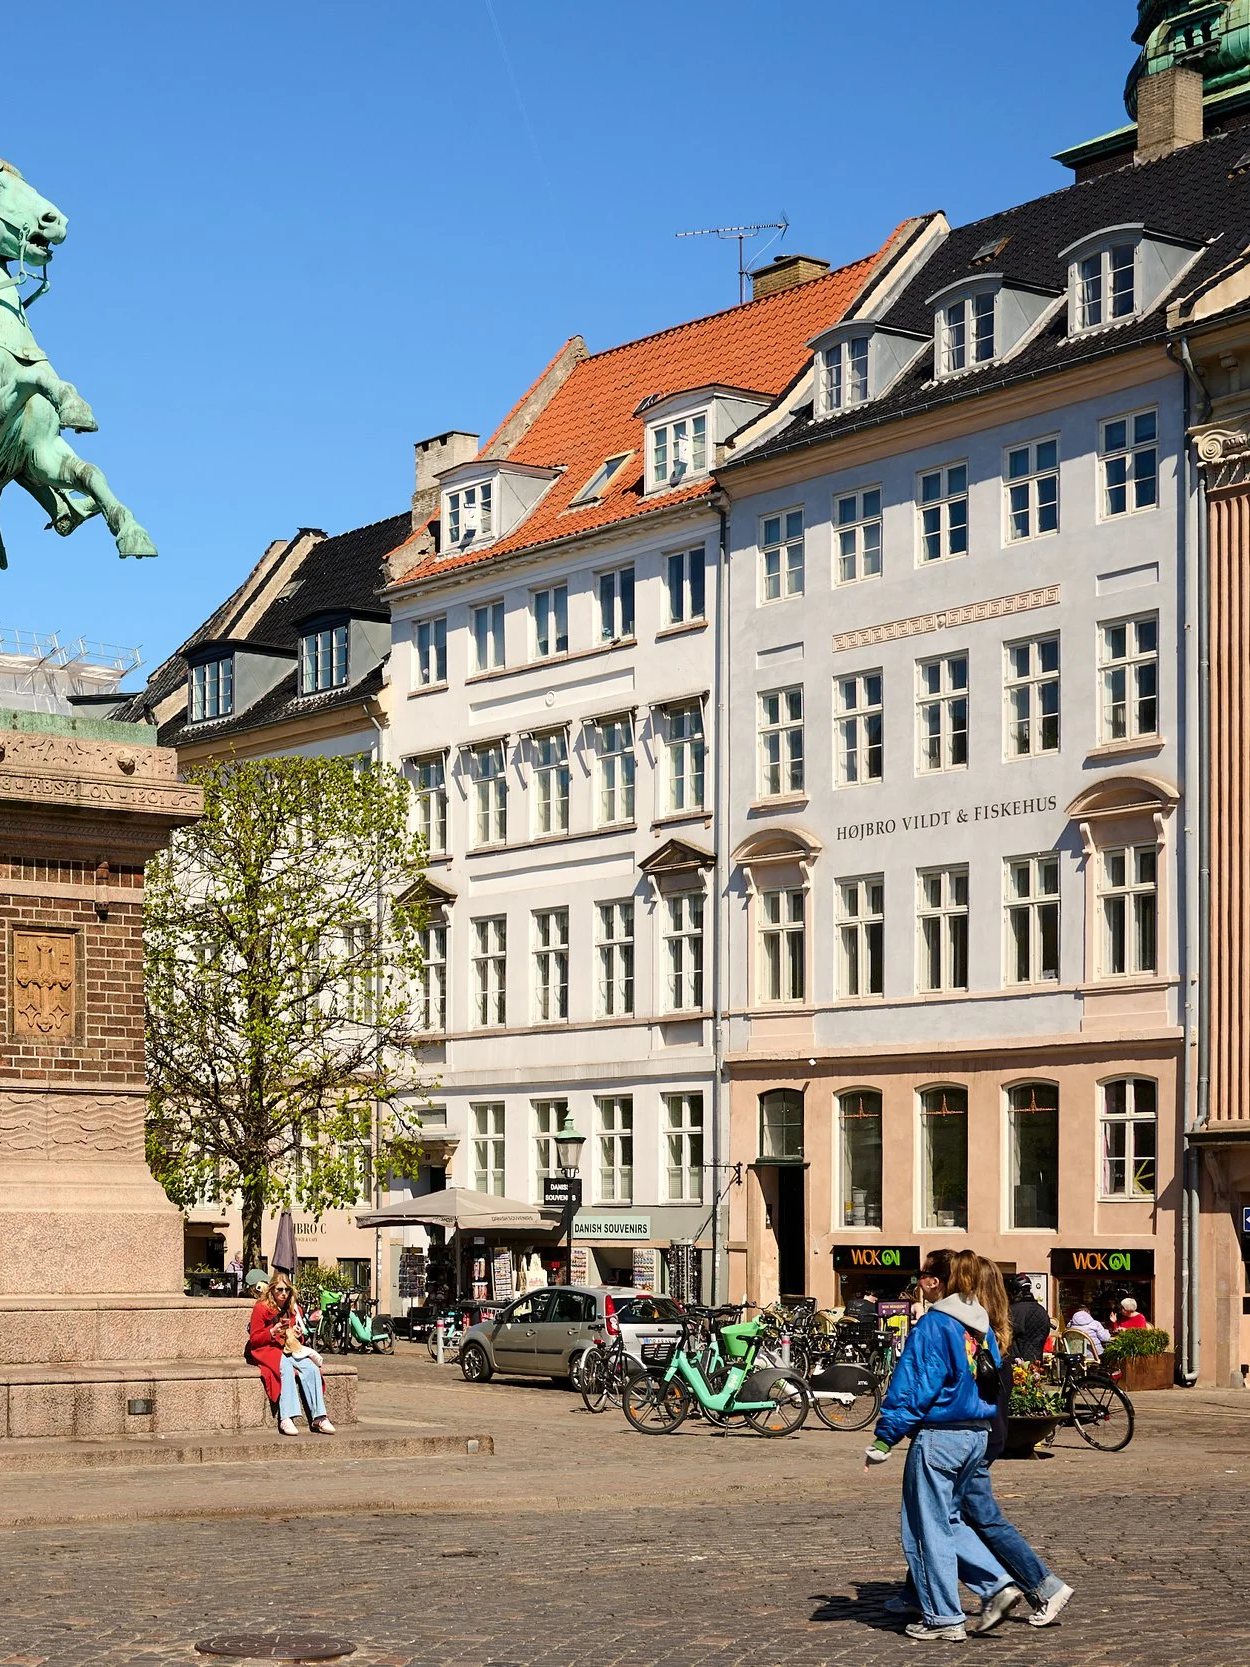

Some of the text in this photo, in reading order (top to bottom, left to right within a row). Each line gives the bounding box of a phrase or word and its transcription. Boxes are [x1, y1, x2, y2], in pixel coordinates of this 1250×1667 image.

[29, 778, 113, 800] ABSALON
[131, 791, 166, 805] 1201
[836, 795, 1057, 841] HØJBRO VILDT & FISKEHUS
[320, 1223, 326, 1234] C
[574, 1224, 648, 1234] DANISH SOUVENIRS
[851, 1249, 882, 1266] WOK
[1072, 1252, 1108, 1270] WOK
